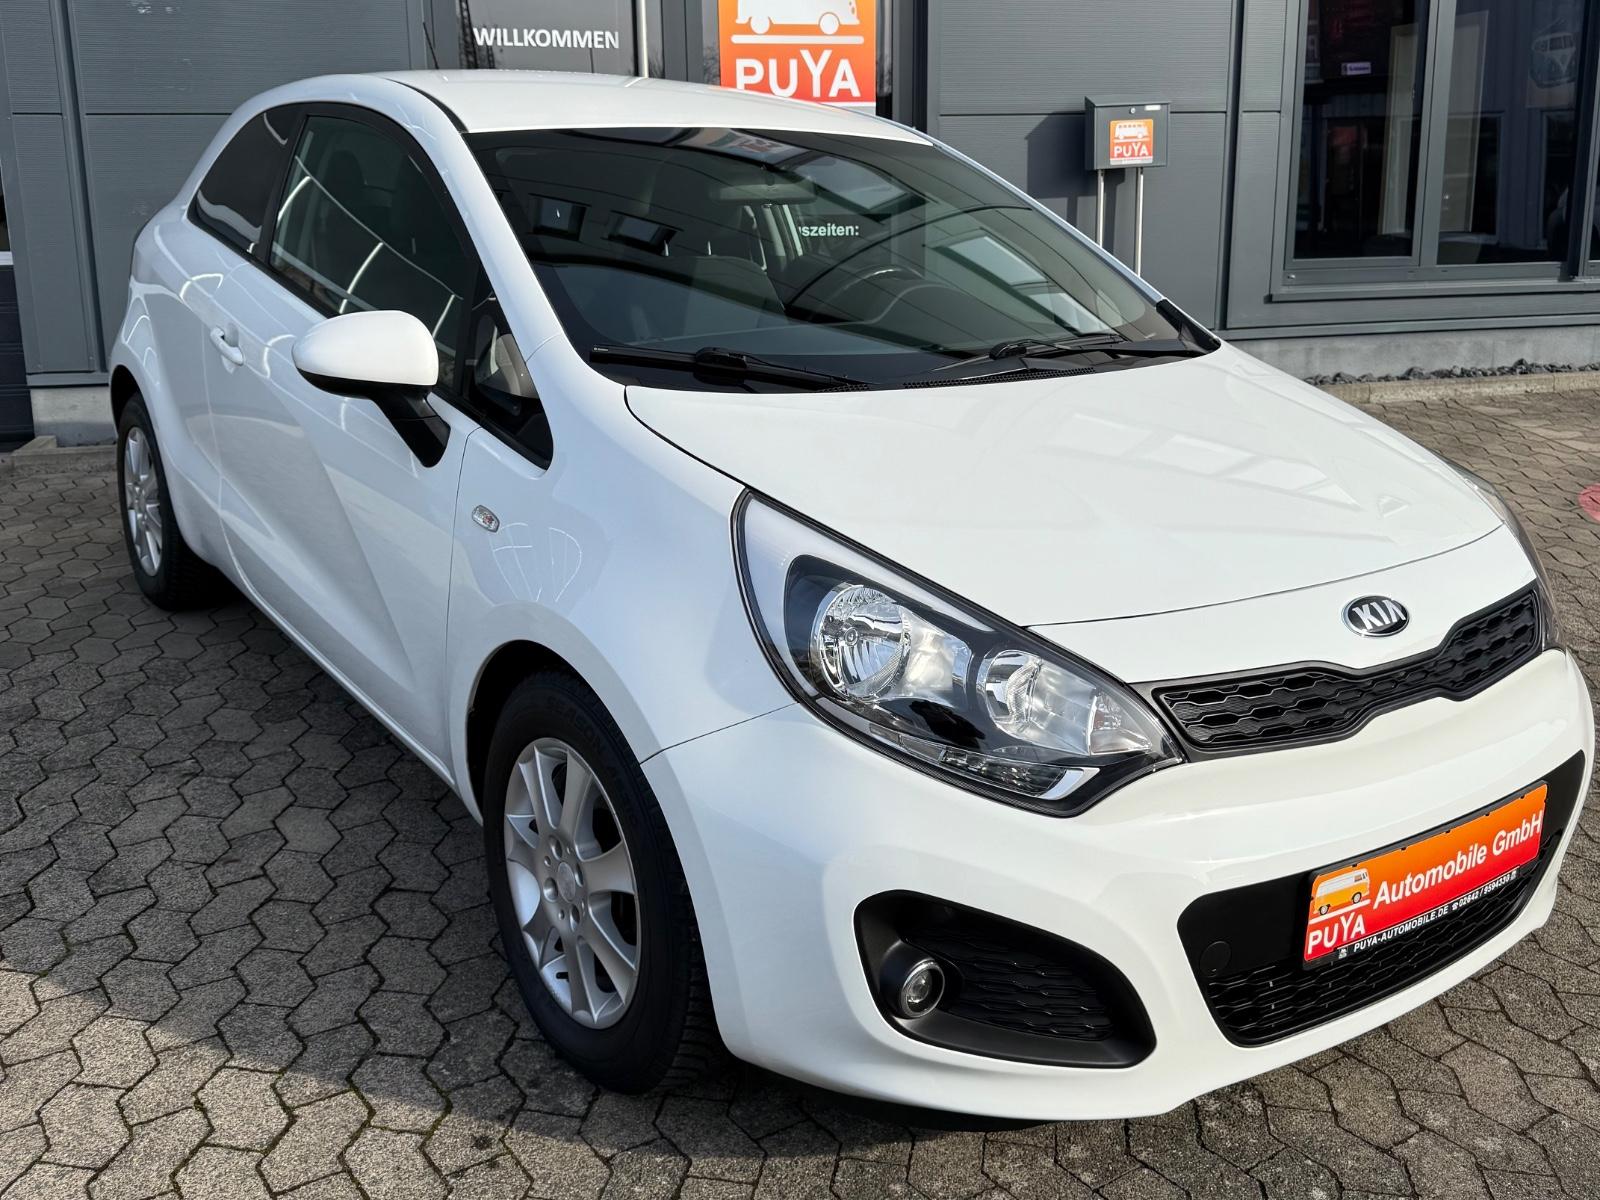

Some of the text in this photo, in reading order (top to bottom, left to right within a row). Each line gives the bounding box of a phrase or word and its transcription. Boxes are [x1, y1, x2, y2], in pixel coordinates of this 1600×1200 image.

[473, 27, 619, 49] WILLKOMMEN
[735, 49, 861, 98] PUYA
[1113, 142, 1149, 158] PUYA
[1352, 599, 1406, 630] KIA
[1374, 810, 1543, 909] Automobile GmbH
[1308, 913, 1366, 955] PUYA
[1353, 907, 1449, 953] PUYA-AUTOMOBILE.DE
